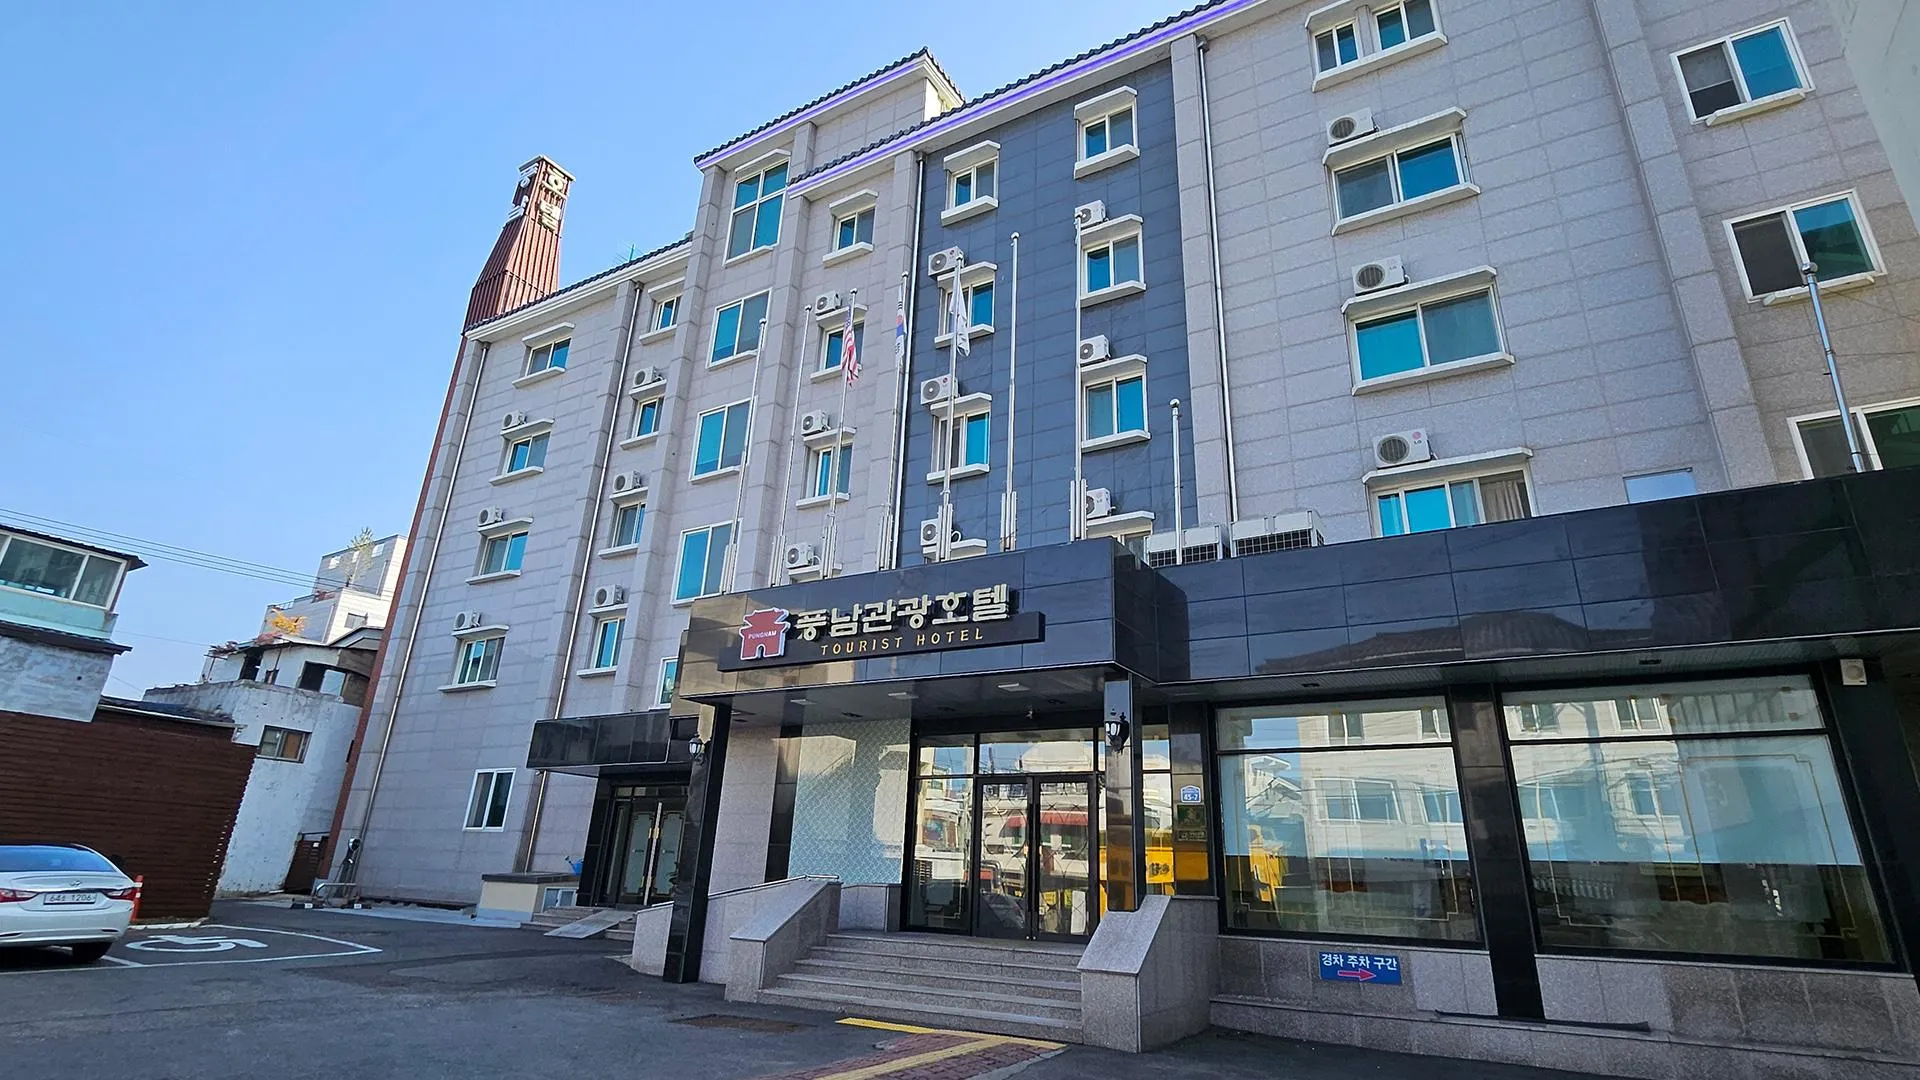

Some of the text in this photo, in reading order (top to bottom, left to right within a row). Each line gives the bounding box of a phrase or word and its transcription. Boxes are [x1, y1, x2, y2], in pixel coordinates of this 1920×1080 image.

[795, 583, 1011, 642] 풍남관광호텔
[748, 630, 777, 639] PUNGNAM
[821, 628, 984, 656] TOURIST HOTEL
[1183, 793, 1198, 801] 45-7
[71, 894, 92, 902] 1206
[1321, 953, 1398, 971] 경차 주차 구간
